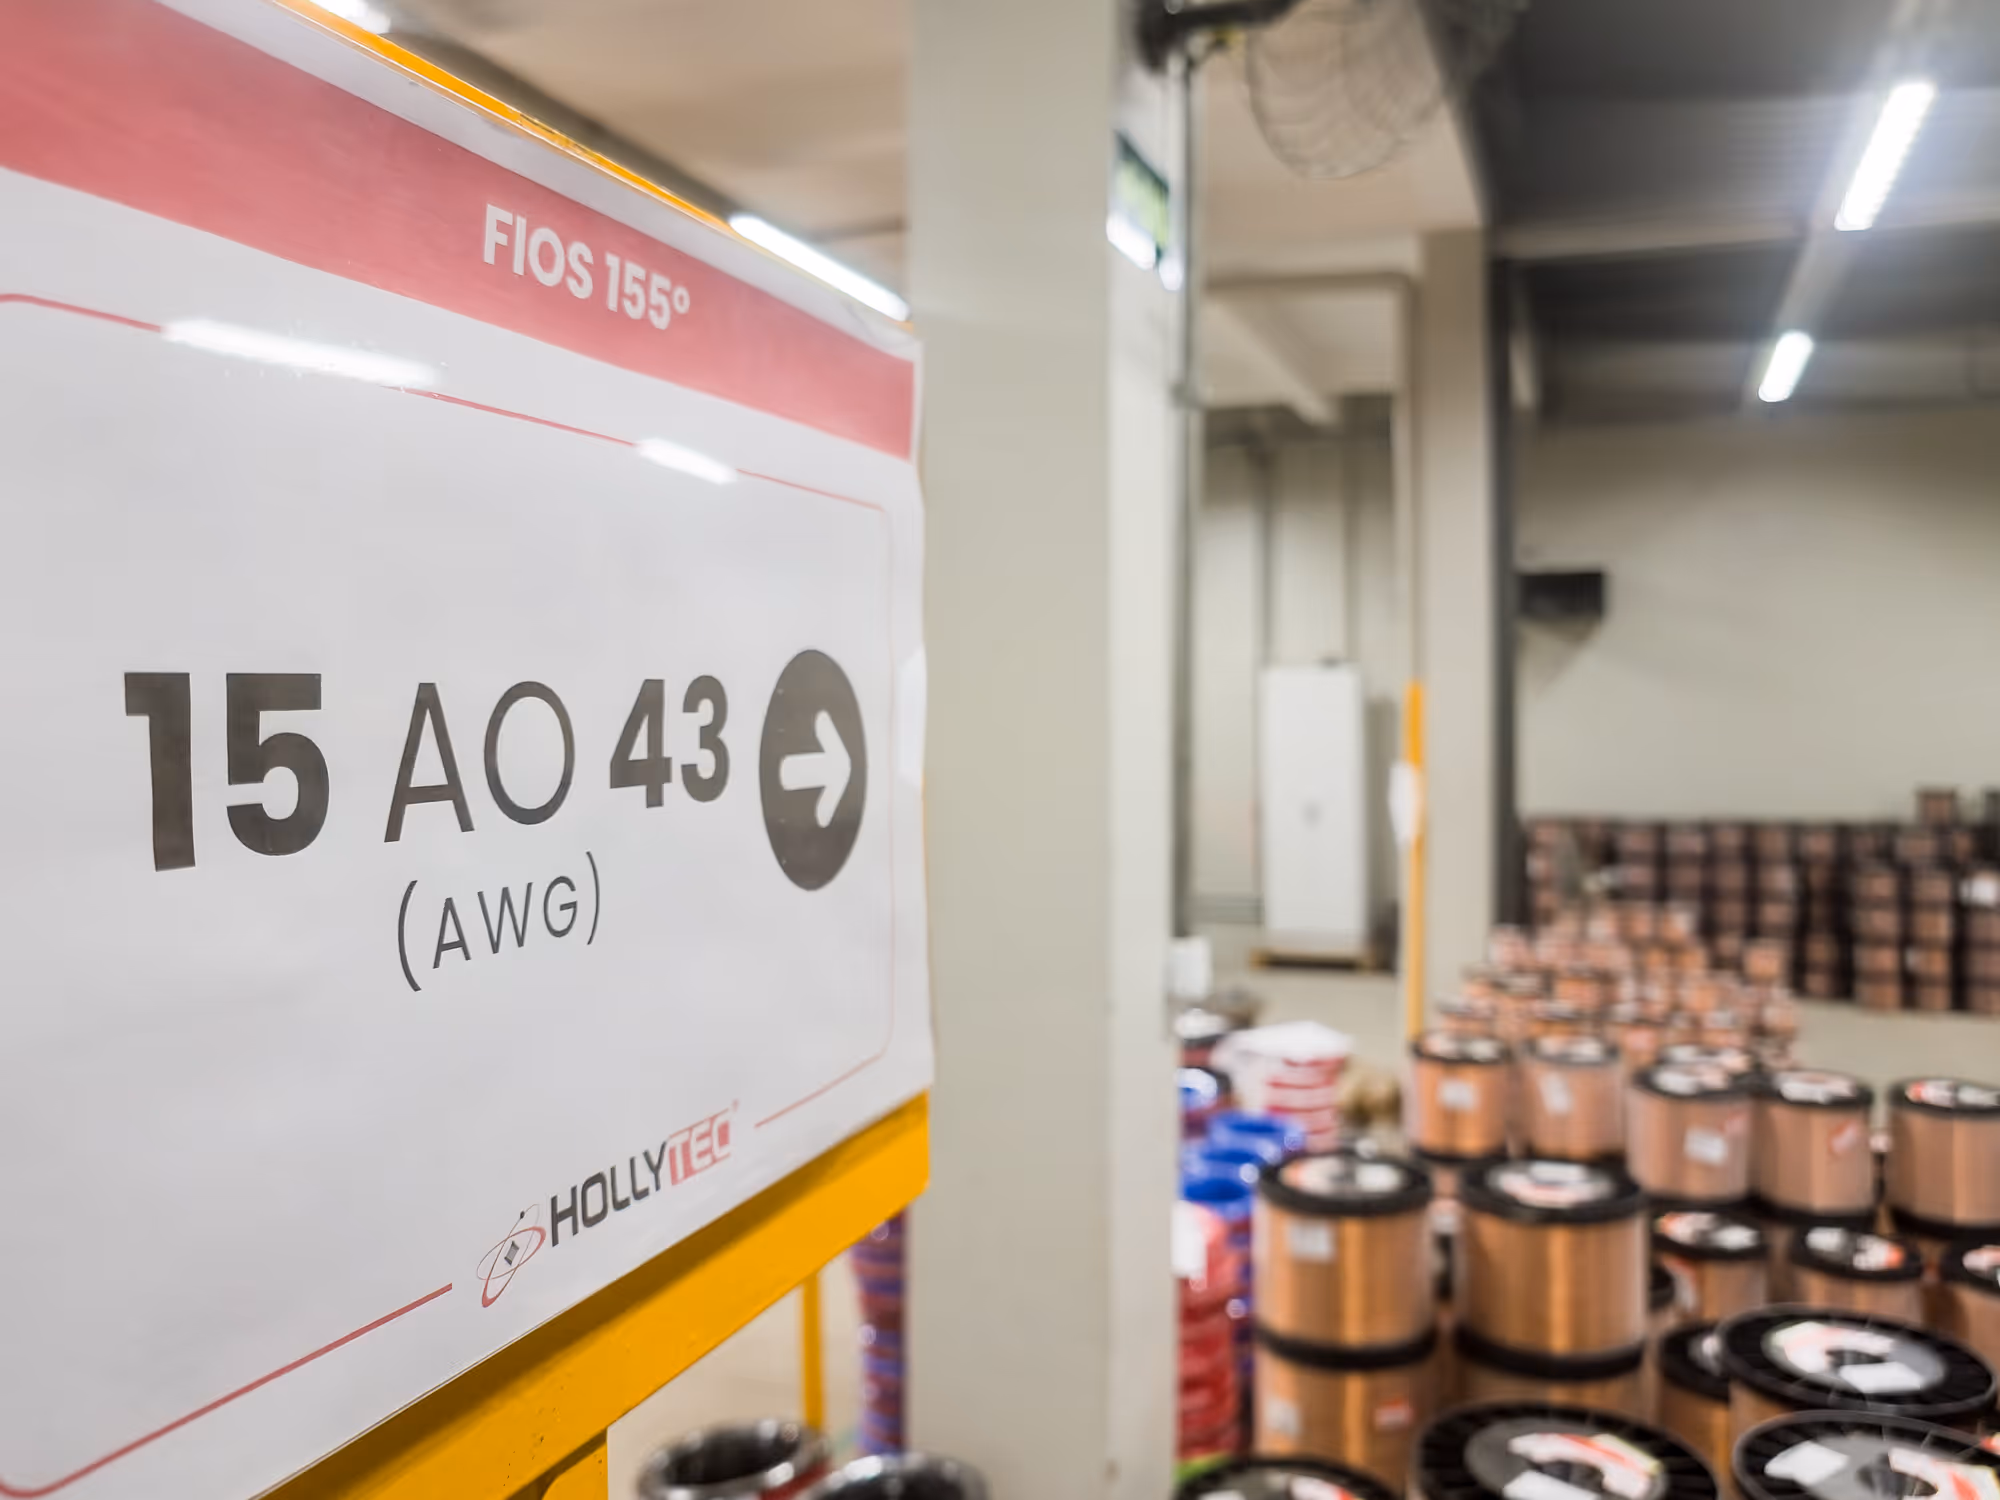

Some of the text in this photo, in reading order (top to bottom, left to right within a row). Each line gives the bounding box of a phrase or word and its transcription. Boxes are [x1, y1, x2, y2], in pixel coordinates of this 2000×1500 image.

[482, 203, 595, 300] FIOS
[123, 671, 730, 873] 15 AO 43
[397, 850, 601, 993] (AWG)
[550, 1108, 735, 1248] HOLLYTEC
